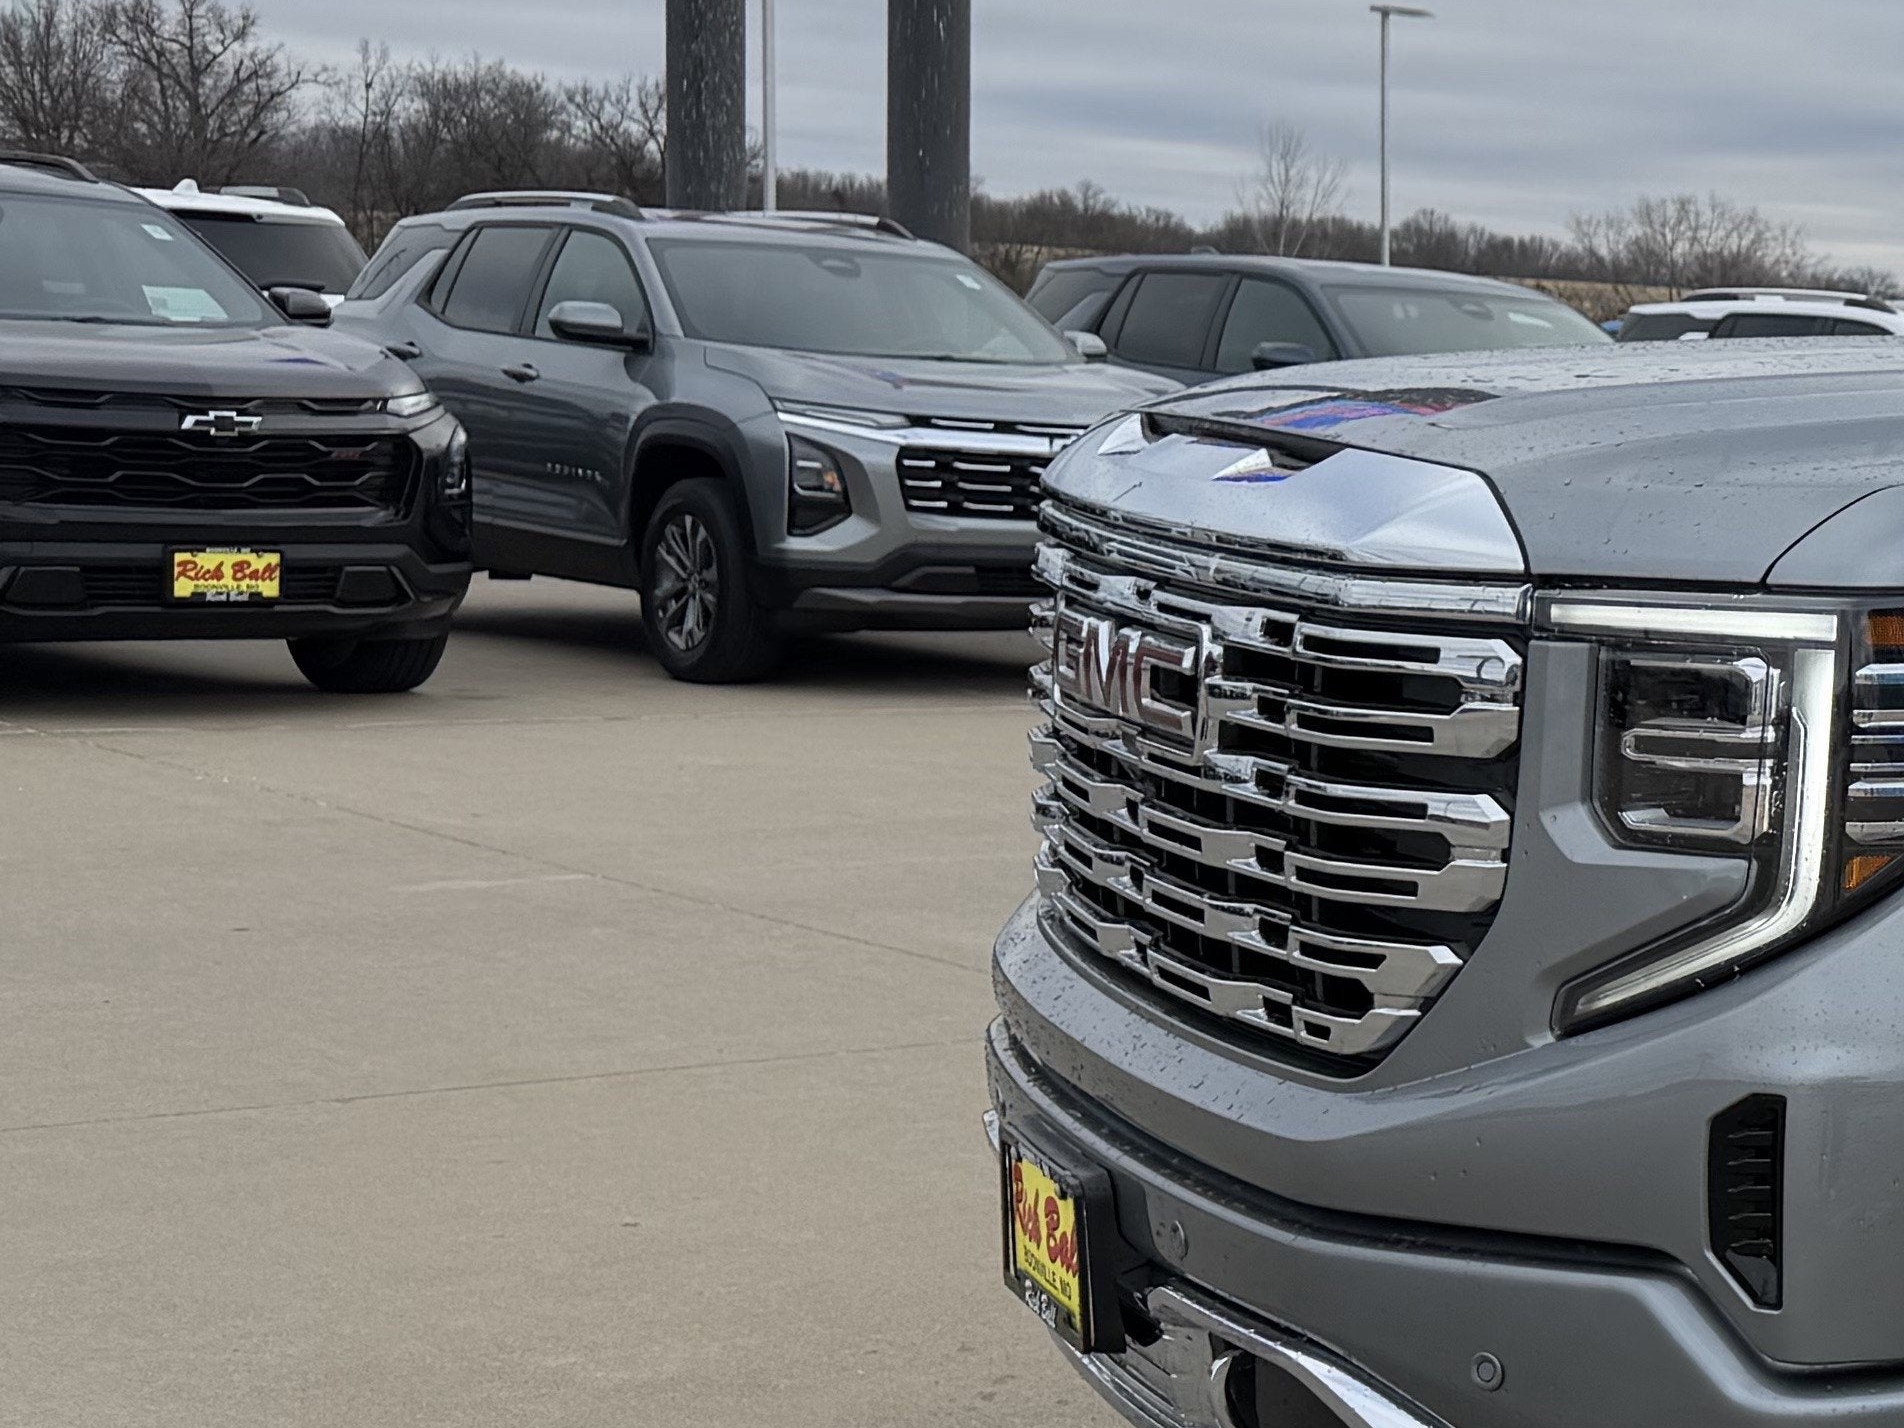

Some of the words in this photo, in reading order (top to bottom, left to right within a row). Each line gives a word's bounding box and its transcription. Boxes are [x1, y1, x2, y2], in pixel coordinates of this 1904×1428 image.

[176, 559, 225, 581] Rick
[231, 559, 280, 582] Ball
[1055, 609, 1196, 740] GMC
